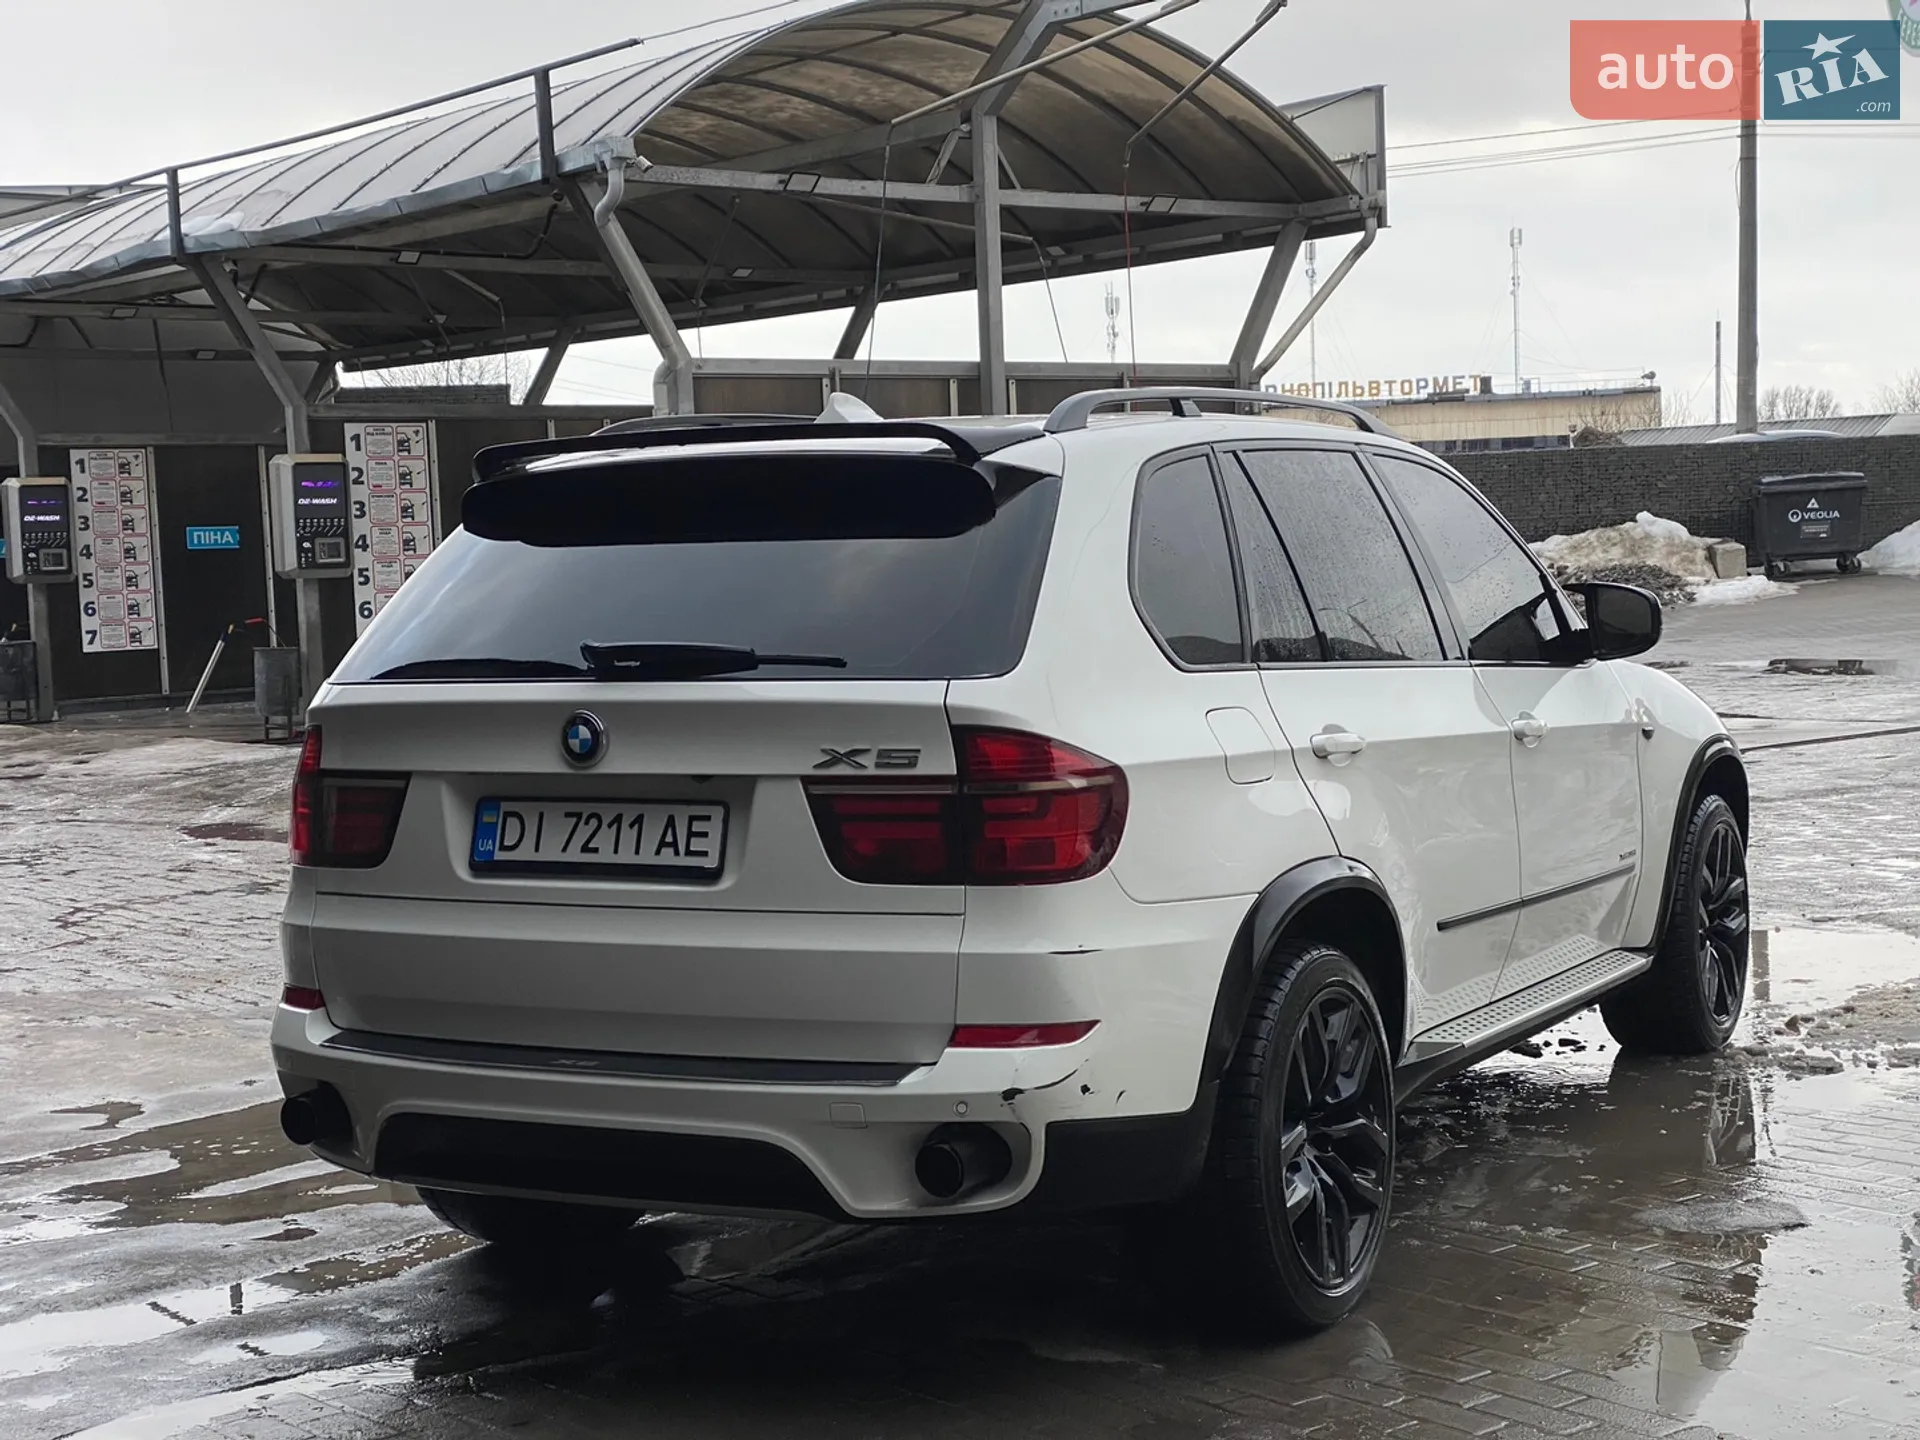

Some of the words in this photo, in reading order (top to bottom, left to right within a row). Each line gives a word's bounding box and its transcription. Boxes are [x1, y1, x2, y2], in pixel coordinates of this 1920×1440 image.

[349, 433, 361, 451] 1
[74, 458, 86, 474] 1
[351, 467, 365, 485] 2
[76, 487, 89, 502] 2
[353, 501, 366, 519] 3
[1803, 510, 1840, 519] VEOLIA
[78, 515, 90, 531] 3
[193, 530, 234, 544] ПІНА
[354, 534, 369, 552] 4
[79, 544, 93, 560] 4
[82, 573, 94, 589] 5
[357, 567, 370, 586] 5
[83, 601, 97, 617] 6
[358, 601, 373, 619] 6
[85, 630, 98, 645] 7
[812, 748, 922, 769] X5
[498, 811, 544, 852] DI
[560, 811, 645, 855] 7211
[654, 814, 712, 857] AE
[478, 839, 493, 851] UA
